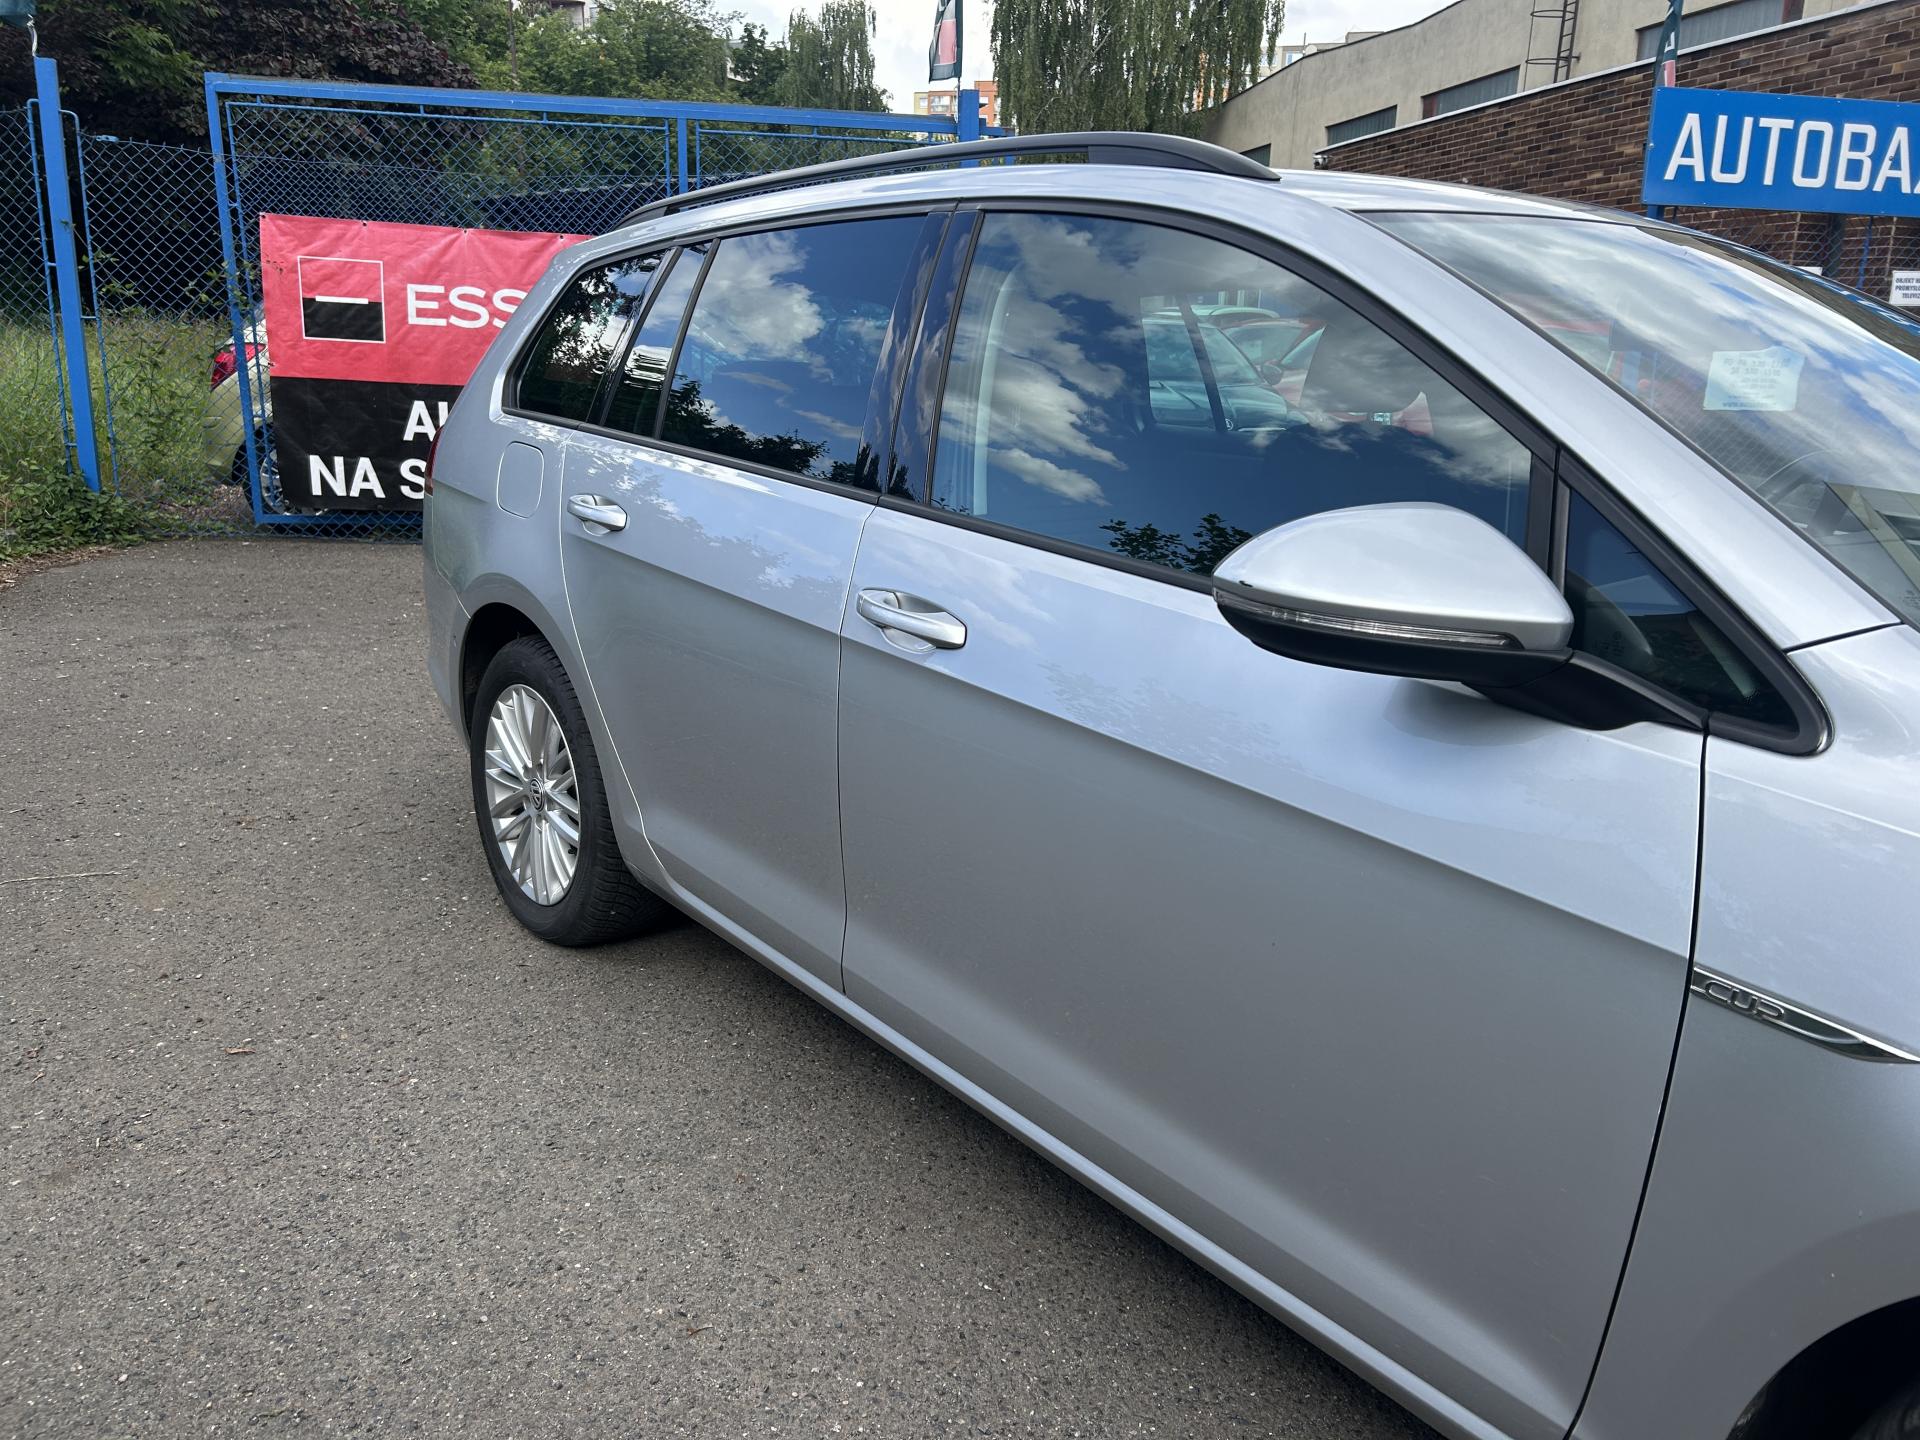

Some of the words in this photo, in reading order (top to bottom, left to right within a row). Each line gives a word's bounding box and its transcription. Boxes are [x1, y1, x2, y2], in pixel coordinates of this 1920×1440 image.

[1663, 112, 1920, 194] AUTOBA
[308, 454, 386, 500] NA
[400, 458, 427, 500] S
[1705, 980, 1785, 1020] CUP
